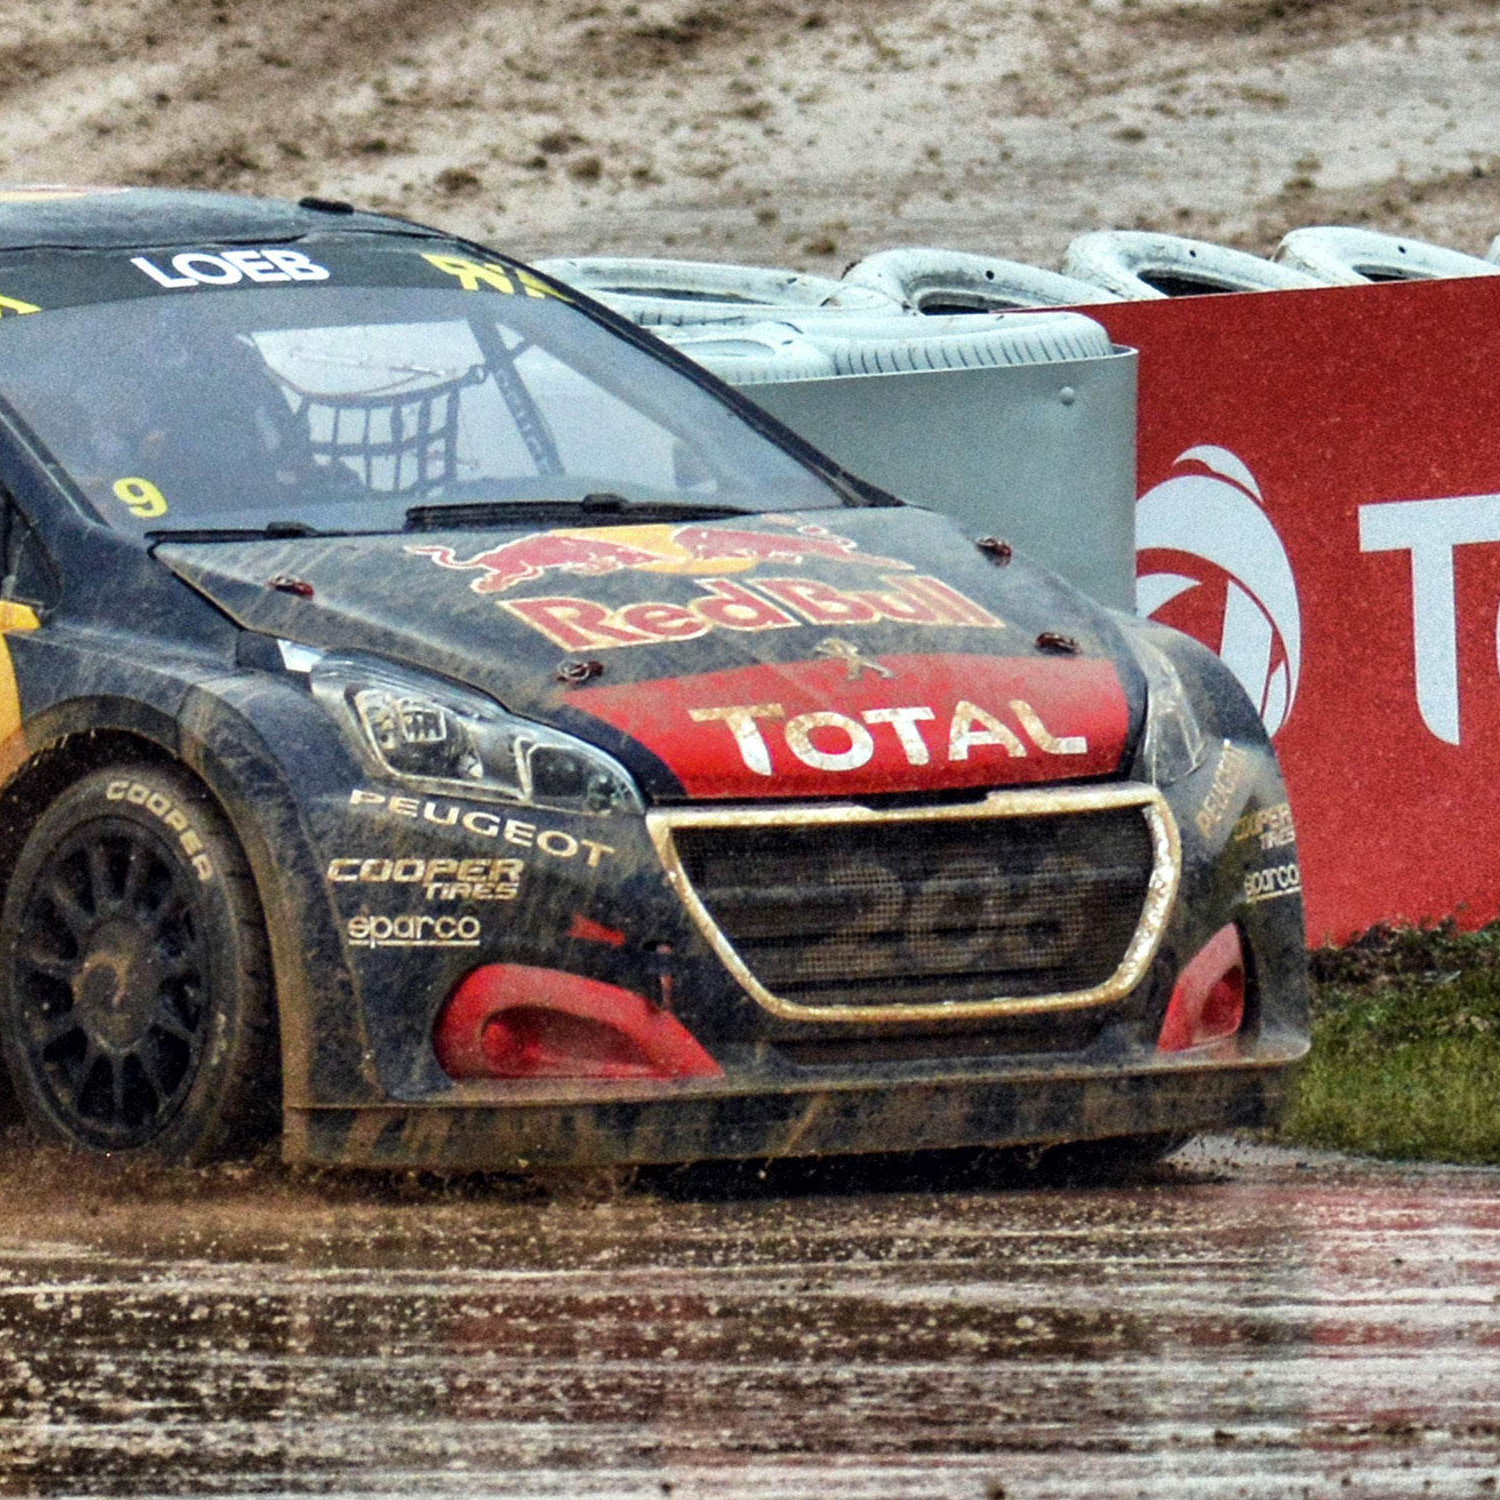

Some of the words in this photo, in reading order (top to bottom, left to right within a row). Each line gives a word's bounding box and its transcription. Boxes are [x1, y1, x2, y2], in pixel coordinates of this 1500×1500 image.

[130, 250, 330, 288] LOEB
[112, 476, 168, 518] 9
[688, 700, 1088, 776] TOTAL
[105, 780, 214, 881] COOPER
[350, 789, 615, 867] PEUGEOT
[327, 858, 525, 883] COOPER
[422, 882, 520, 900] TIRES
[348, 914, 481, 948] sparco
